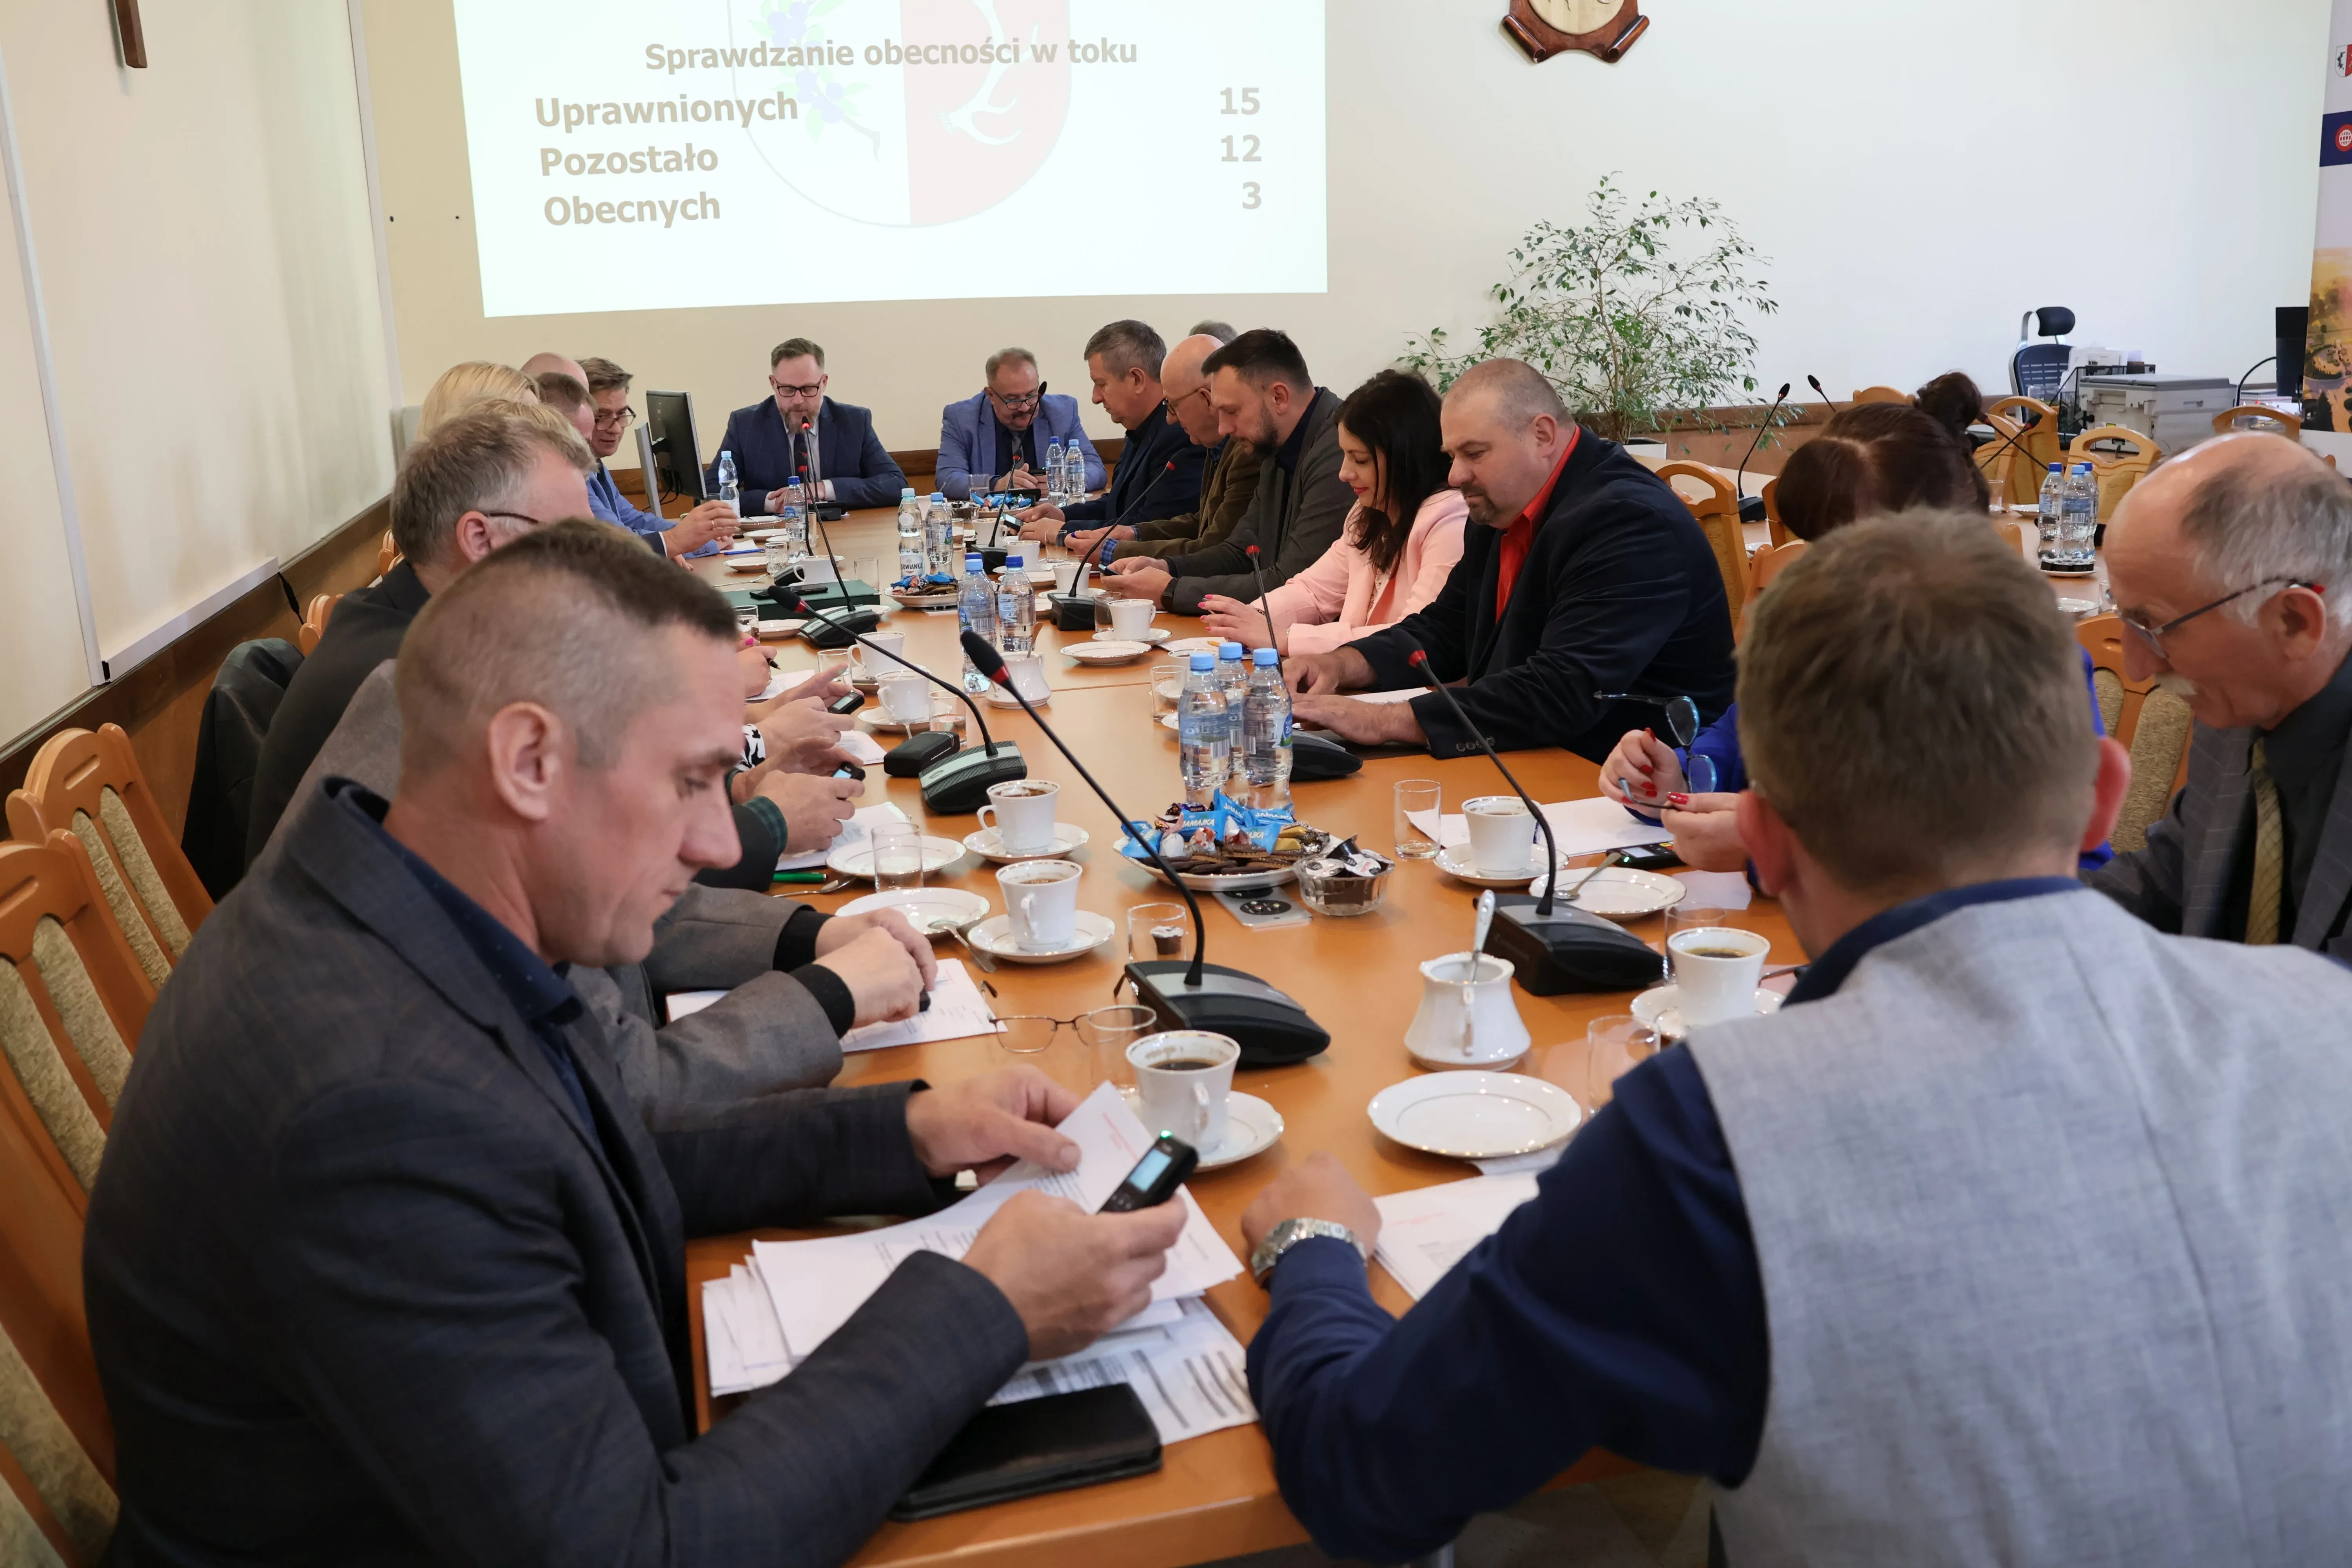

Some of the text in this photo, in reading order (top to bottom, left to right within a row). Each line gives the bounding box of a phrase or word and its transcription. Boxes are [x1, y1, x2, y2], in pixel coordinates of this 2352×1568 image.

[646, 36, 1136, 75] Sprawdzanie obecności w toku
[535, 91, 798, 134] Uprawnionych
[1220, 87, 1260, 115] 15
[540, 143, 718, 176] Pozostało
[1221, 134, 1261, 162] 12
[544, 191, 720, 228] Obecnych
[1243, 182, 1261, 209] 3
[1182, 818, 1215, 828] JAMAJKA
